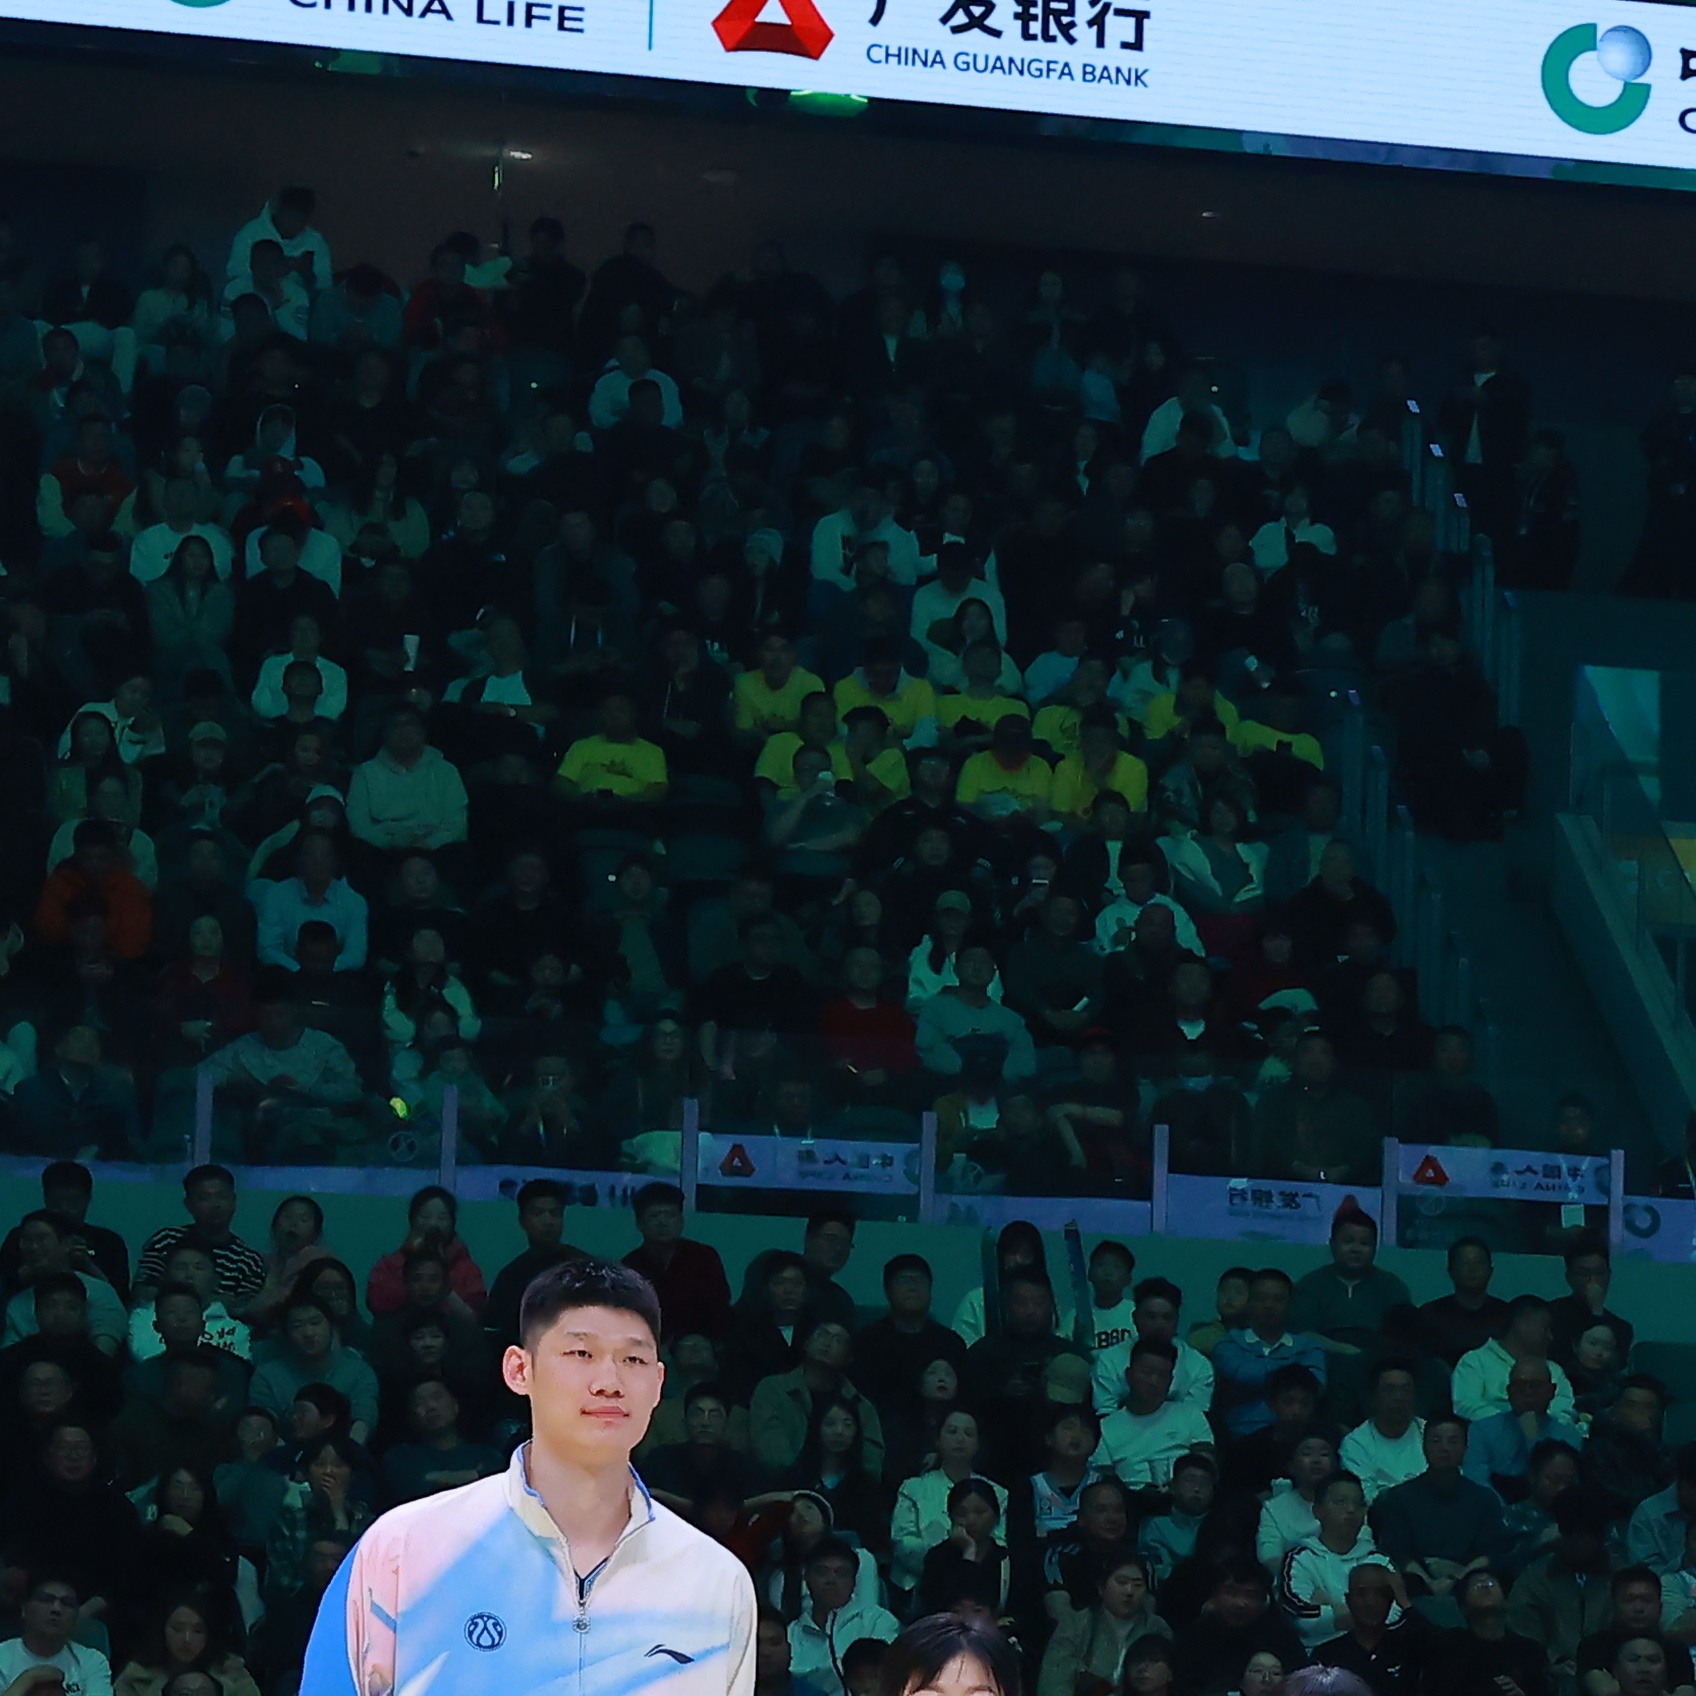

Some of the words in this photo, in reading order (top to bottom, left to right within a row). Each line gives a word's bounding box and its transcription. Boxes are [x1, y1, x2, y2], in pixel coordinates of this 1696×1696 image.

[475, 0, 586, 34] LIFE
[866, 43, 947, 71] CHINA
[953, 51, 1076, 82] GUANGFA
[1081, 62, 1150, 89] BANK
